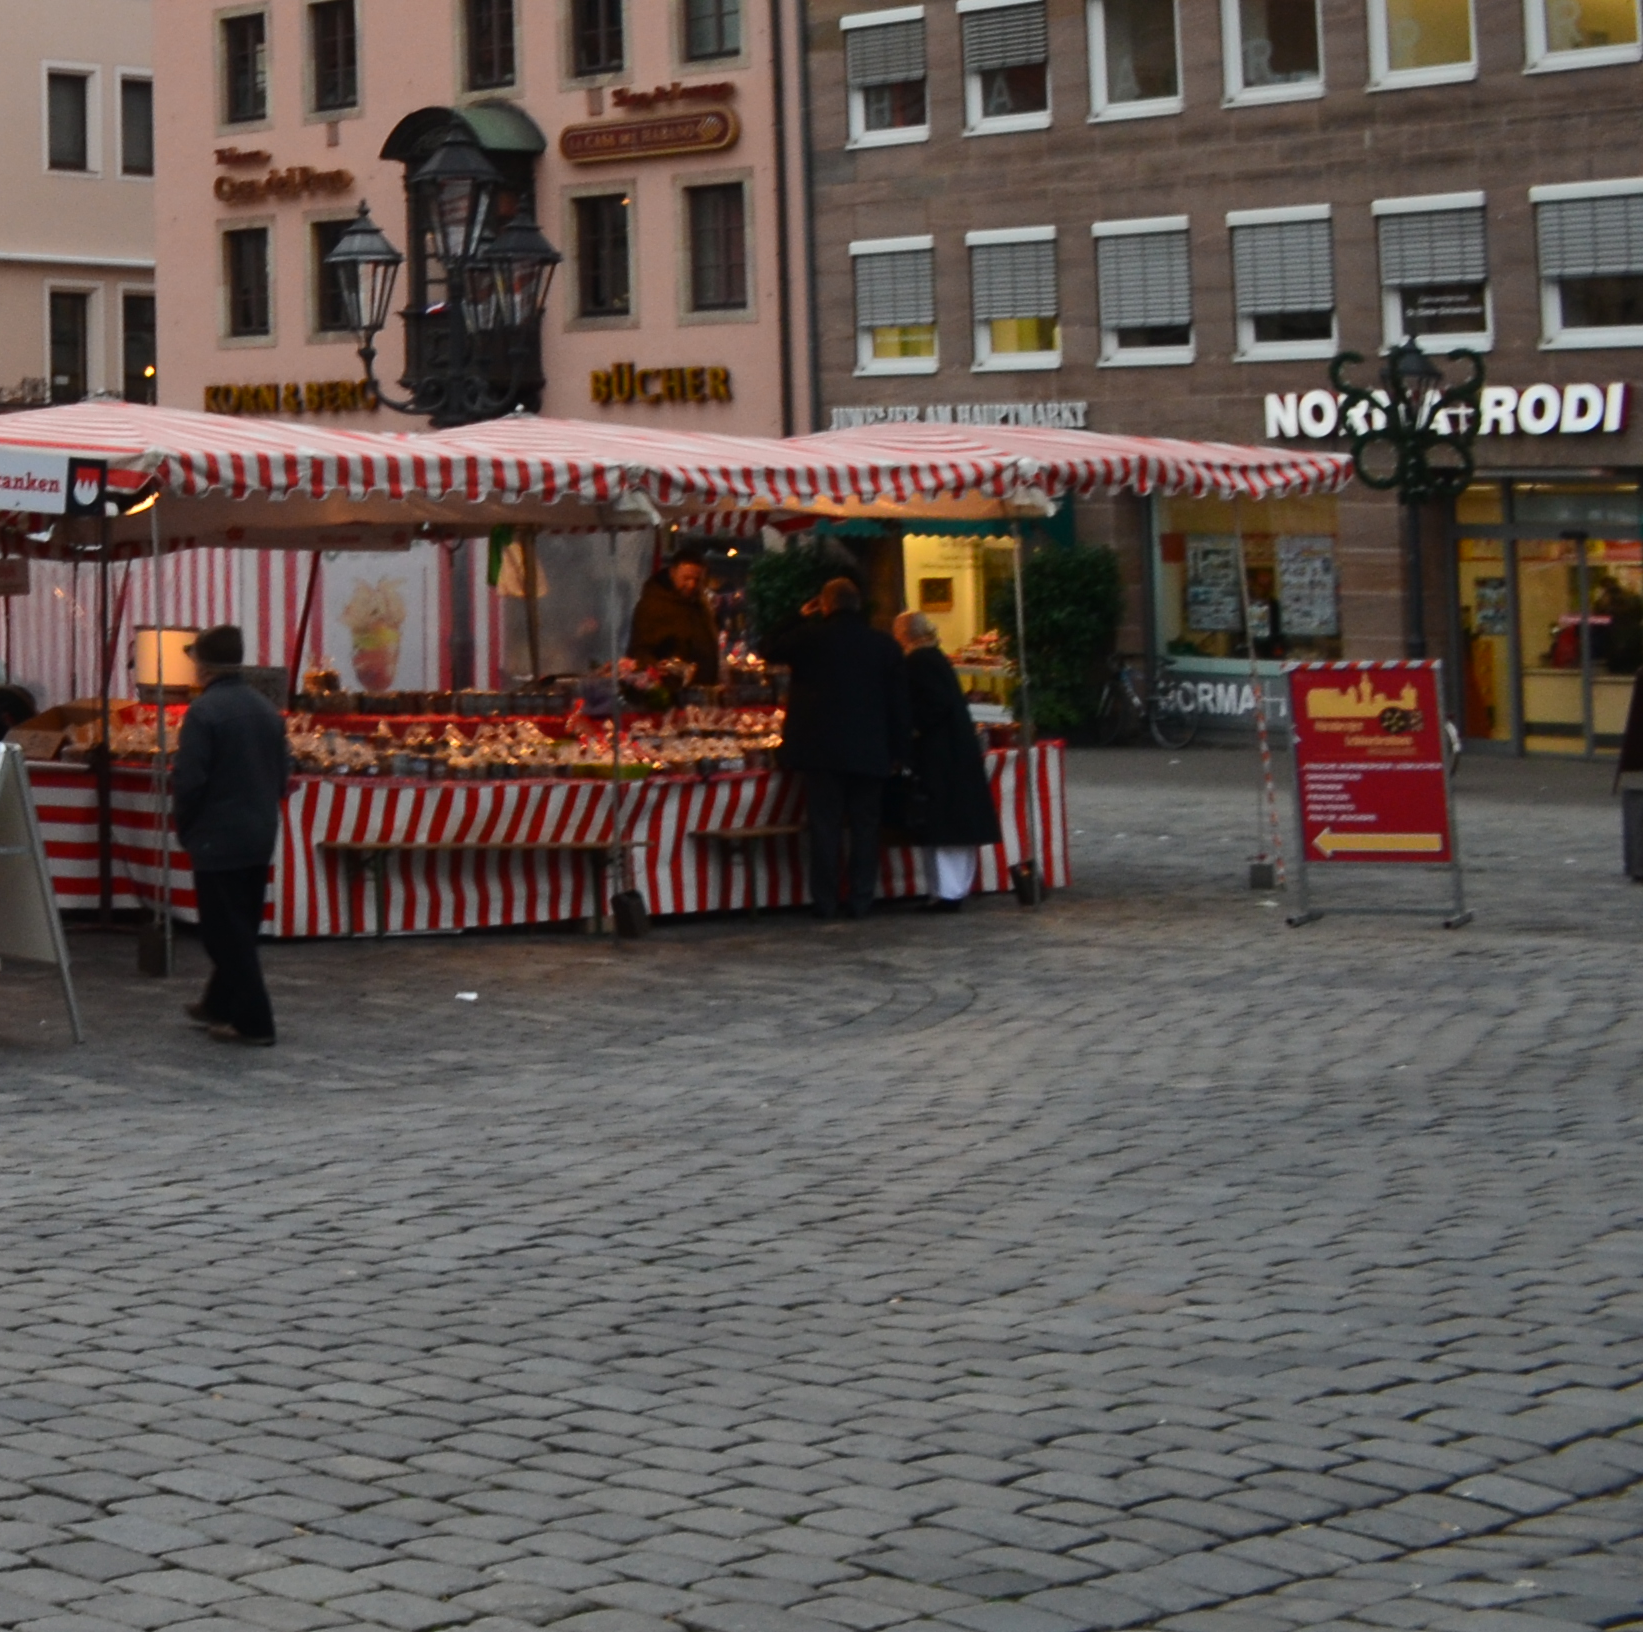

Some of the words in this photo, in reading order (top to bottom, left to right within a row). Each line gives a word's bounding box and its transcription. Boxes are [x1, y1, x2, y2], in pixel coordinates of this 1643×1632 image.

[203, 383, 280, 415] KORN
[282, 381, 303, 413] &
[590, 363, 733, 404] BÜCHER
[956, 400, 1088, 429] HAUPTMARKT
[1477, 382, 1627, 435] RODI
